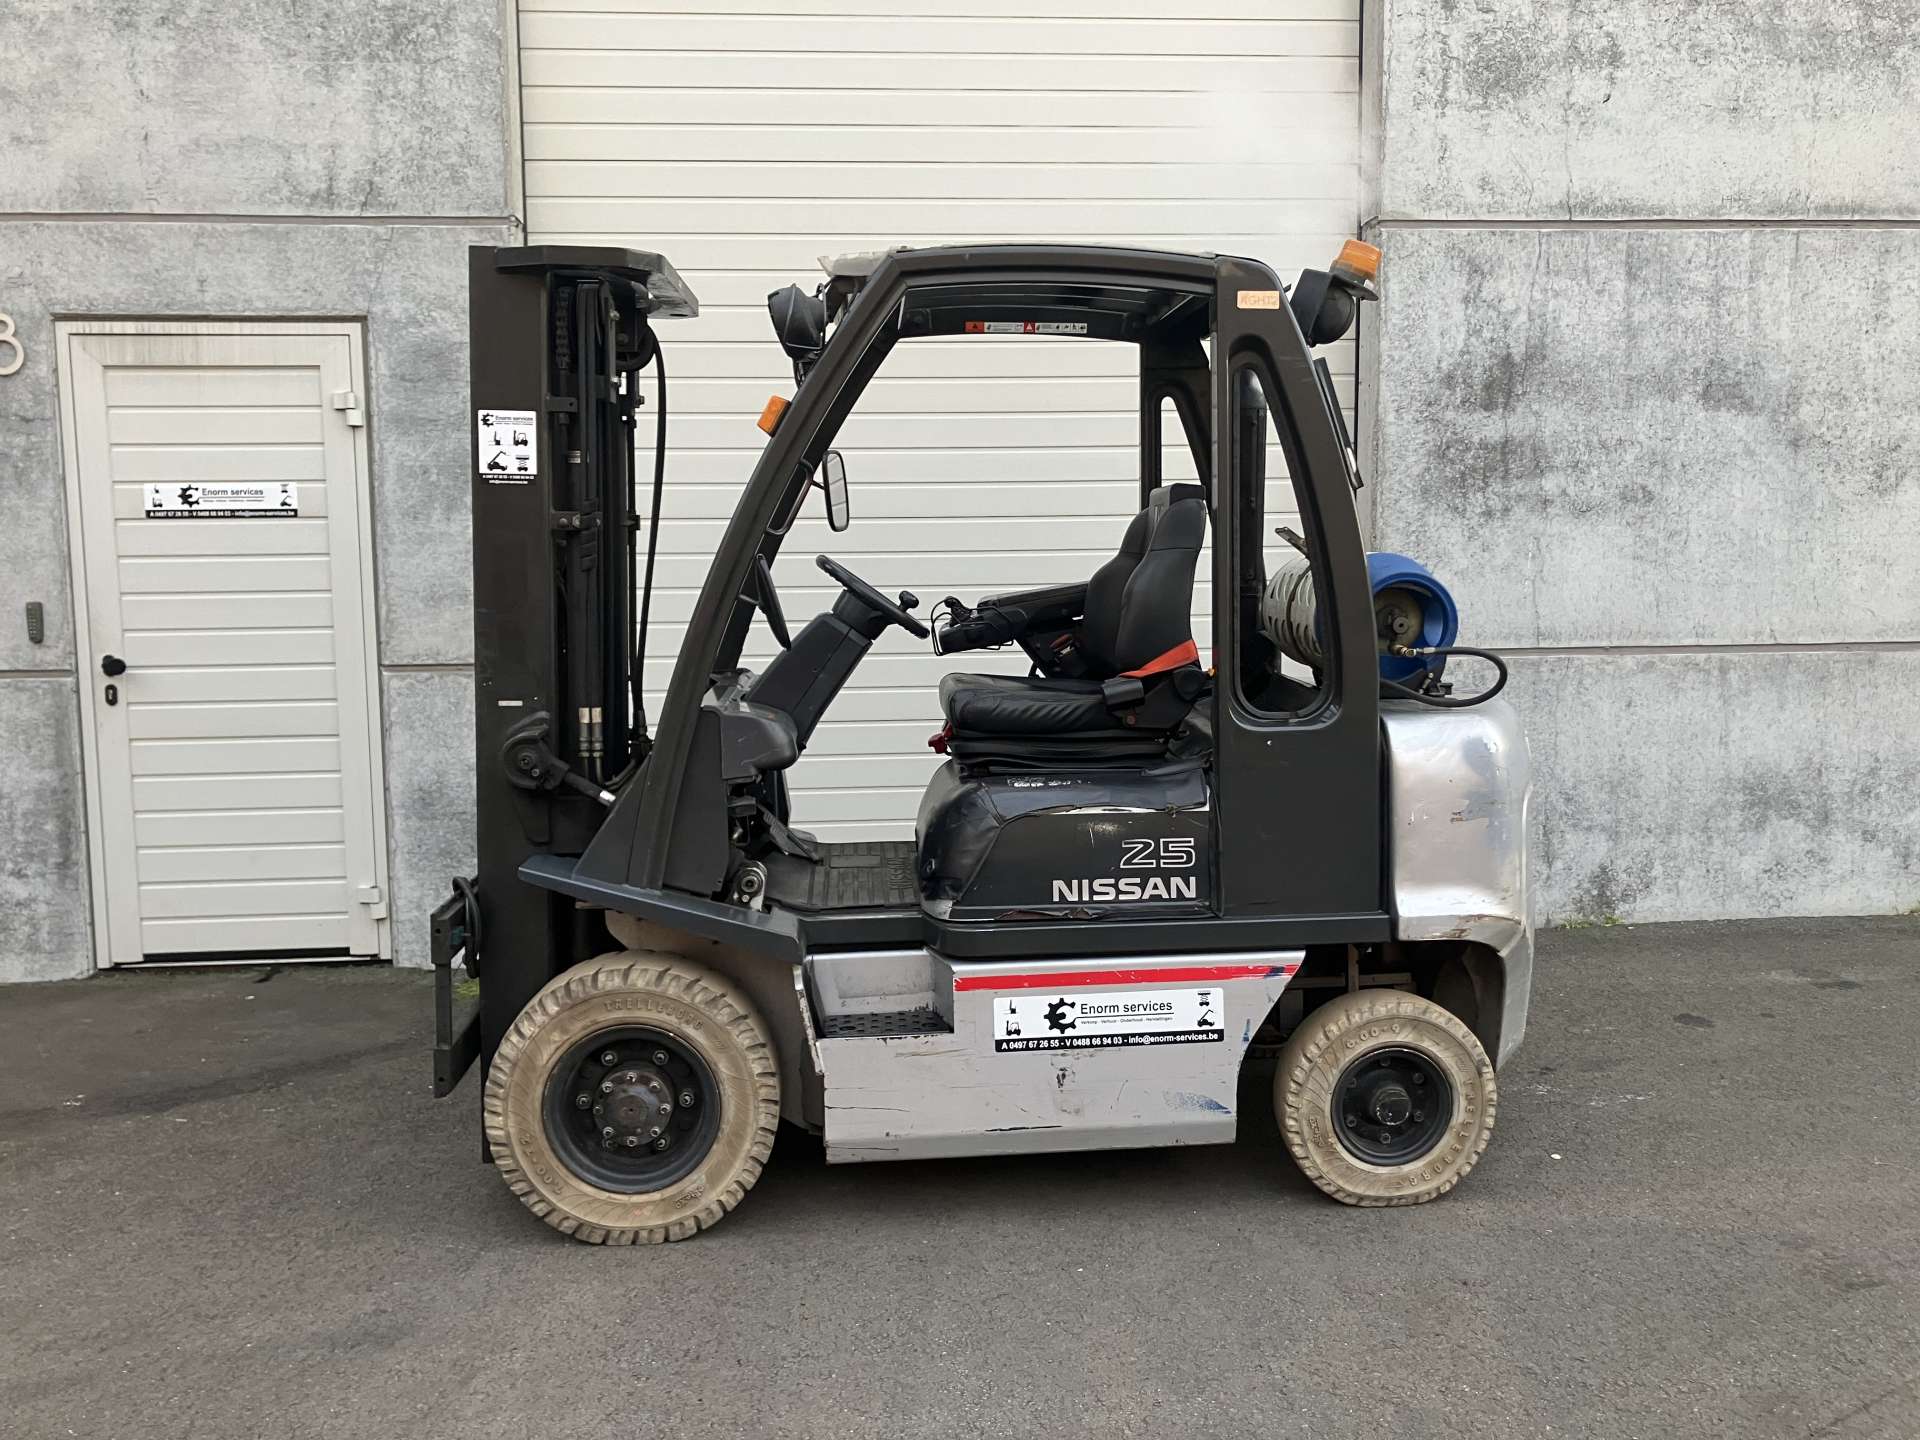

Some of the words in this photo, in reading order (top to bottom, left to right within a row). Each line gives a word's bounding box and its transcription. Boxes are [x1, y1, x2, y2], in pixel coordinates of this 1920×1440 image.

[201, 487, 228, 496] Enorm
[230, 487, 264, 496] services
[1119, 837, 1196, 869] 25
[1052, 876, 1197, 902] NISSAN
[1080, 1003, 1120, 1015] Enorm
[1123, 1000, 1173, 1013] services
[1001, 1042, 1008, 1050] A
[1009, 1041, 1027, 1049] 0497
[1028, 1040, 1037, 1048] 67
[1040, 1040, 1049, 1048] 26
[1050, 1039, 1060, 1047] 55
[1065, 1038, 1072, 1046] V
[1072, 1038, 1090, 1046] 0488
[1091, 1037, 1101, 1045] 66
[1102, 1037, 1112, 1045] 94
[1113, 1036, 1123, 1044] 03
[1128, 1032, 1219, 1044] info@enorm-services.be
